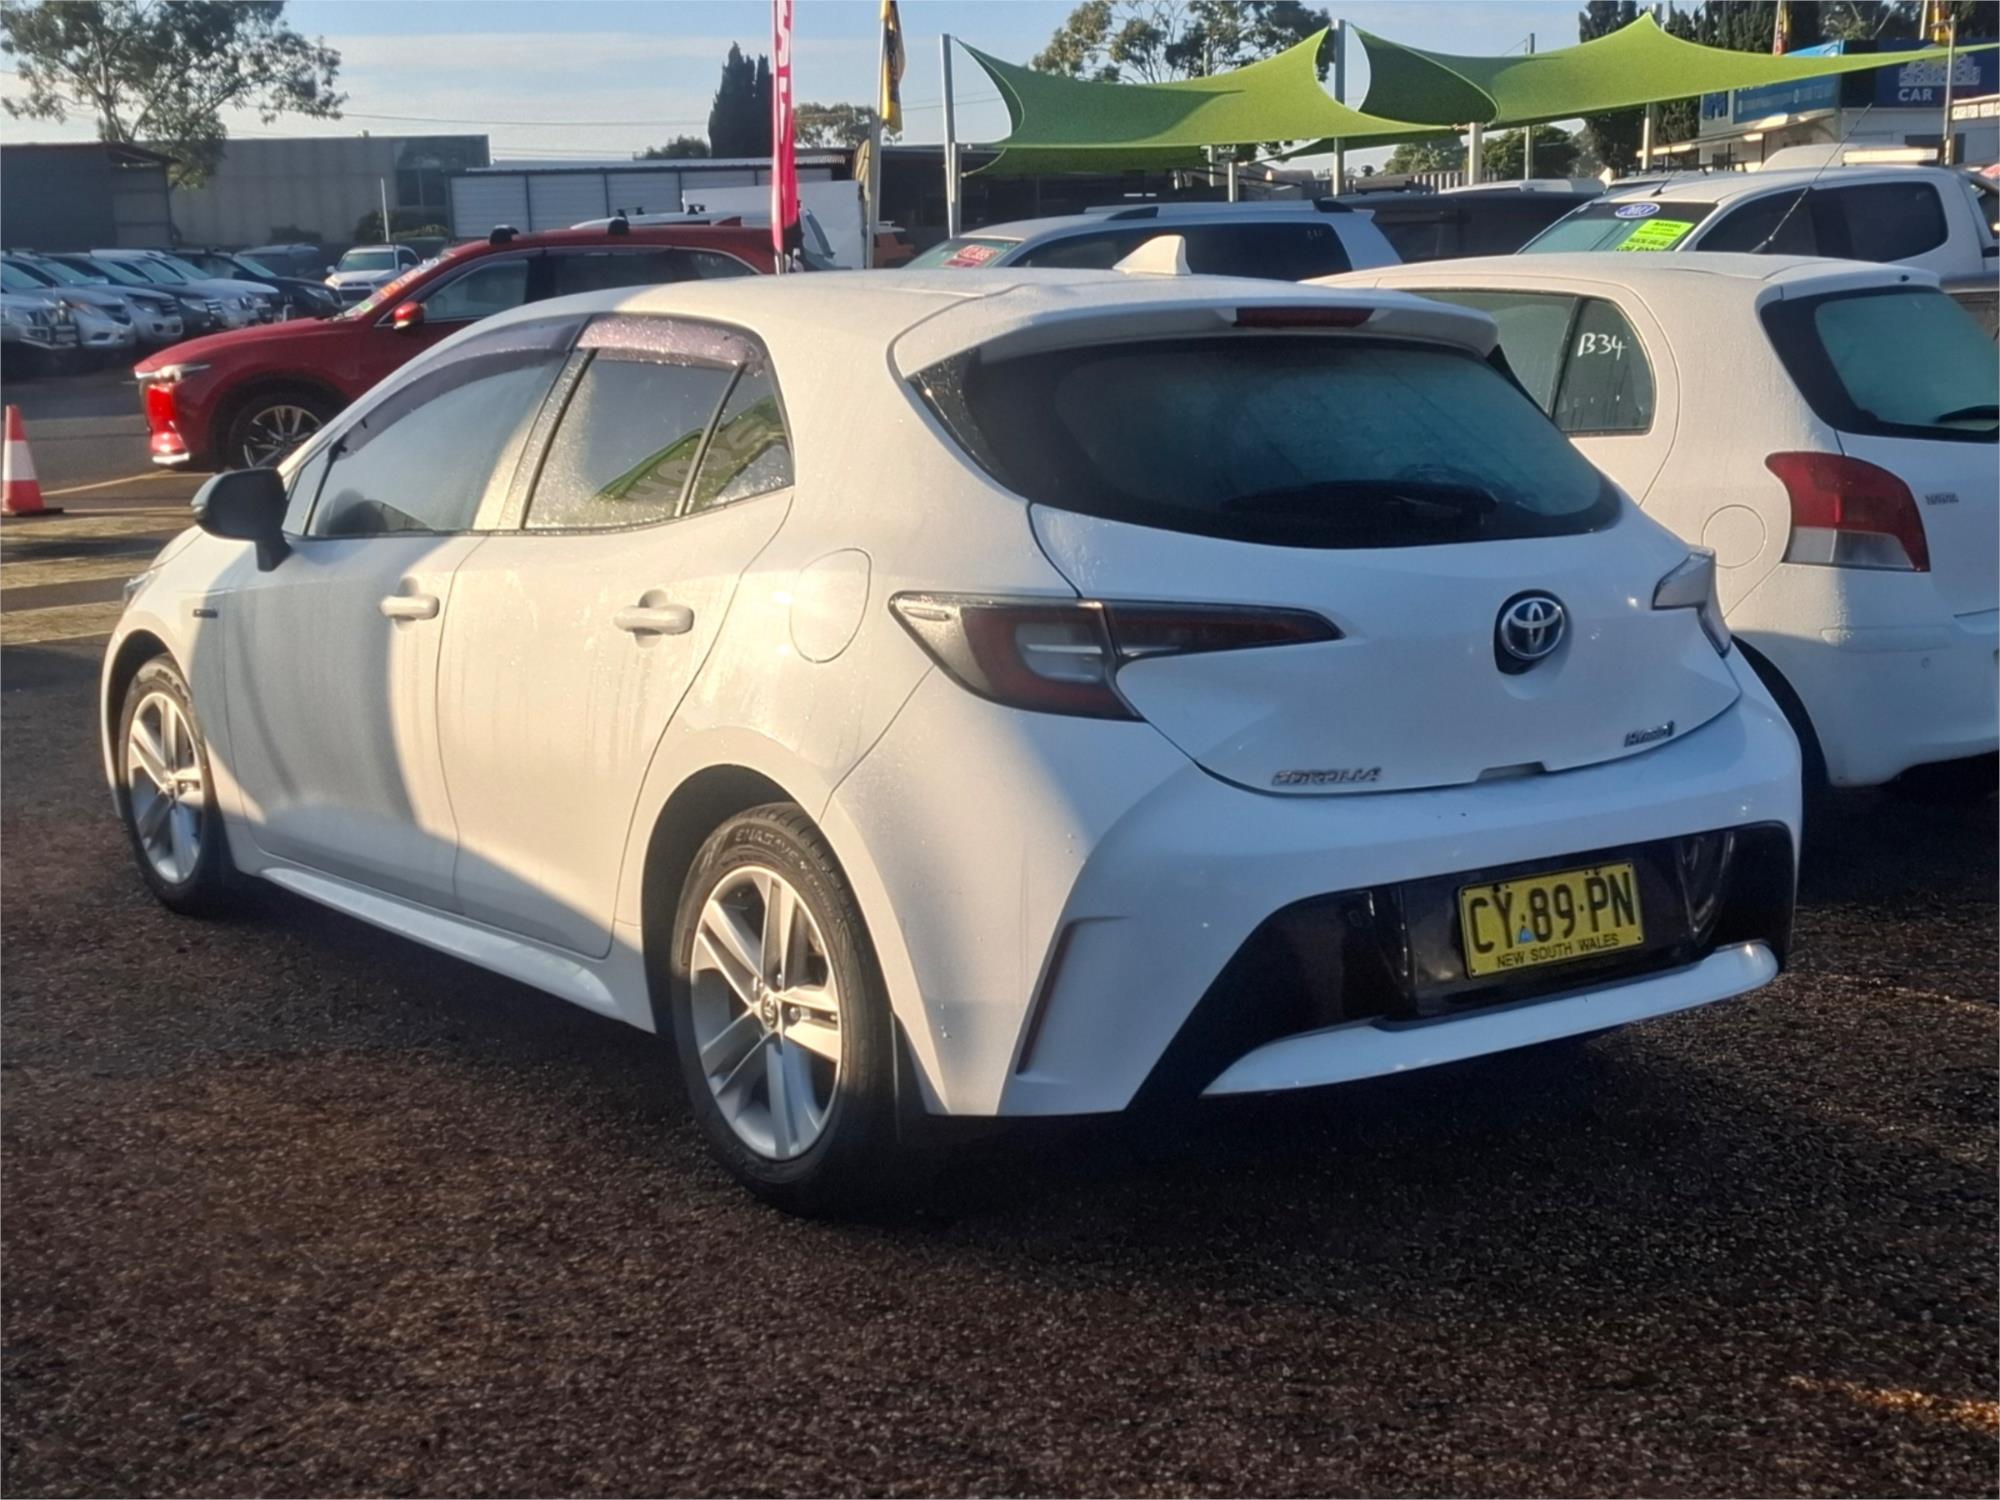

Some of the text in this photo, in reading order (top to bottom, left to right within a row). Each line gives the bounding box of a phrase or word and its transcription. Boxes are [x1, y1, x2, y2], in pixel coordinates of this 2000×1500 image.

[1898, 88, 1932, 102] CAR
[1577, 332, 1627, 361] B34
[1497, 933, 1620, 968] NEW SOUTH WALES
